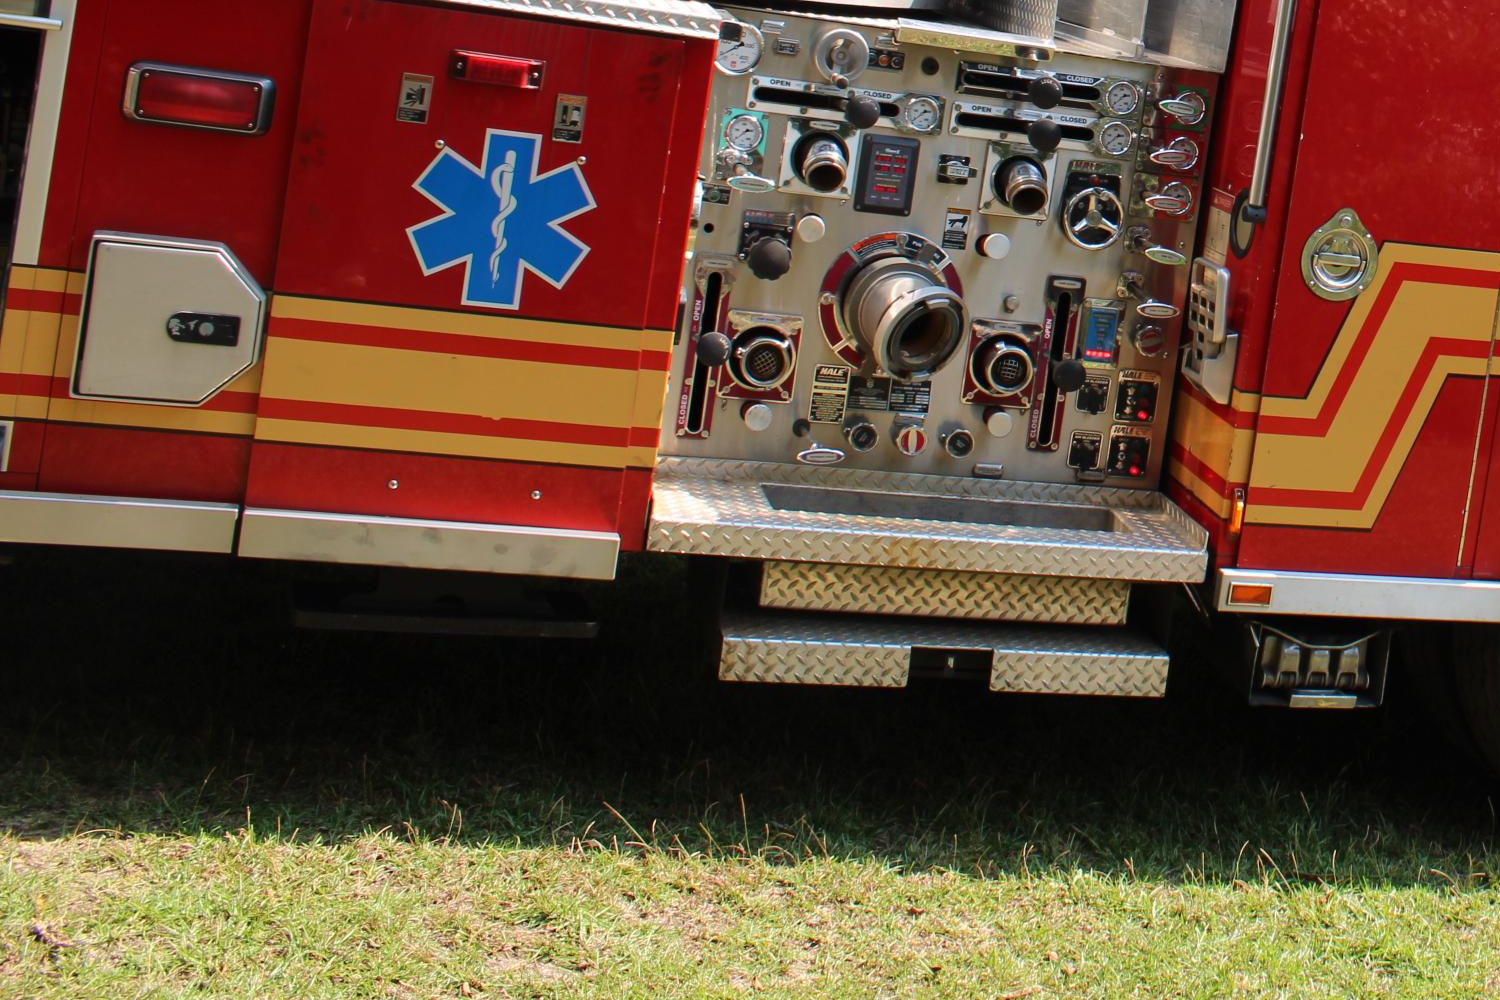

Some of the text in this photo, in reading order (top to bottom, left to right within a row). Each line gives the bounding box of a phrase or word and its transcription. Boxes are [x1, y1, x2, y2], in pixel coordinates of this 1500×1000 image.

[977, 63, 1094, 85] OPEN CLOSED
[769, 78, 892, 100] OPEN CLOSED
[971, 105, 1087, 125] OPEN CLOSED
[692, 299, 702, 321] OPEN
[1044, 318, 1053, 340] OPEN
[819, 367, 845, 377] HALE
[677, 394, 689, 425] CLOSED
[1030, 408, 1040, 439] CLOSED
